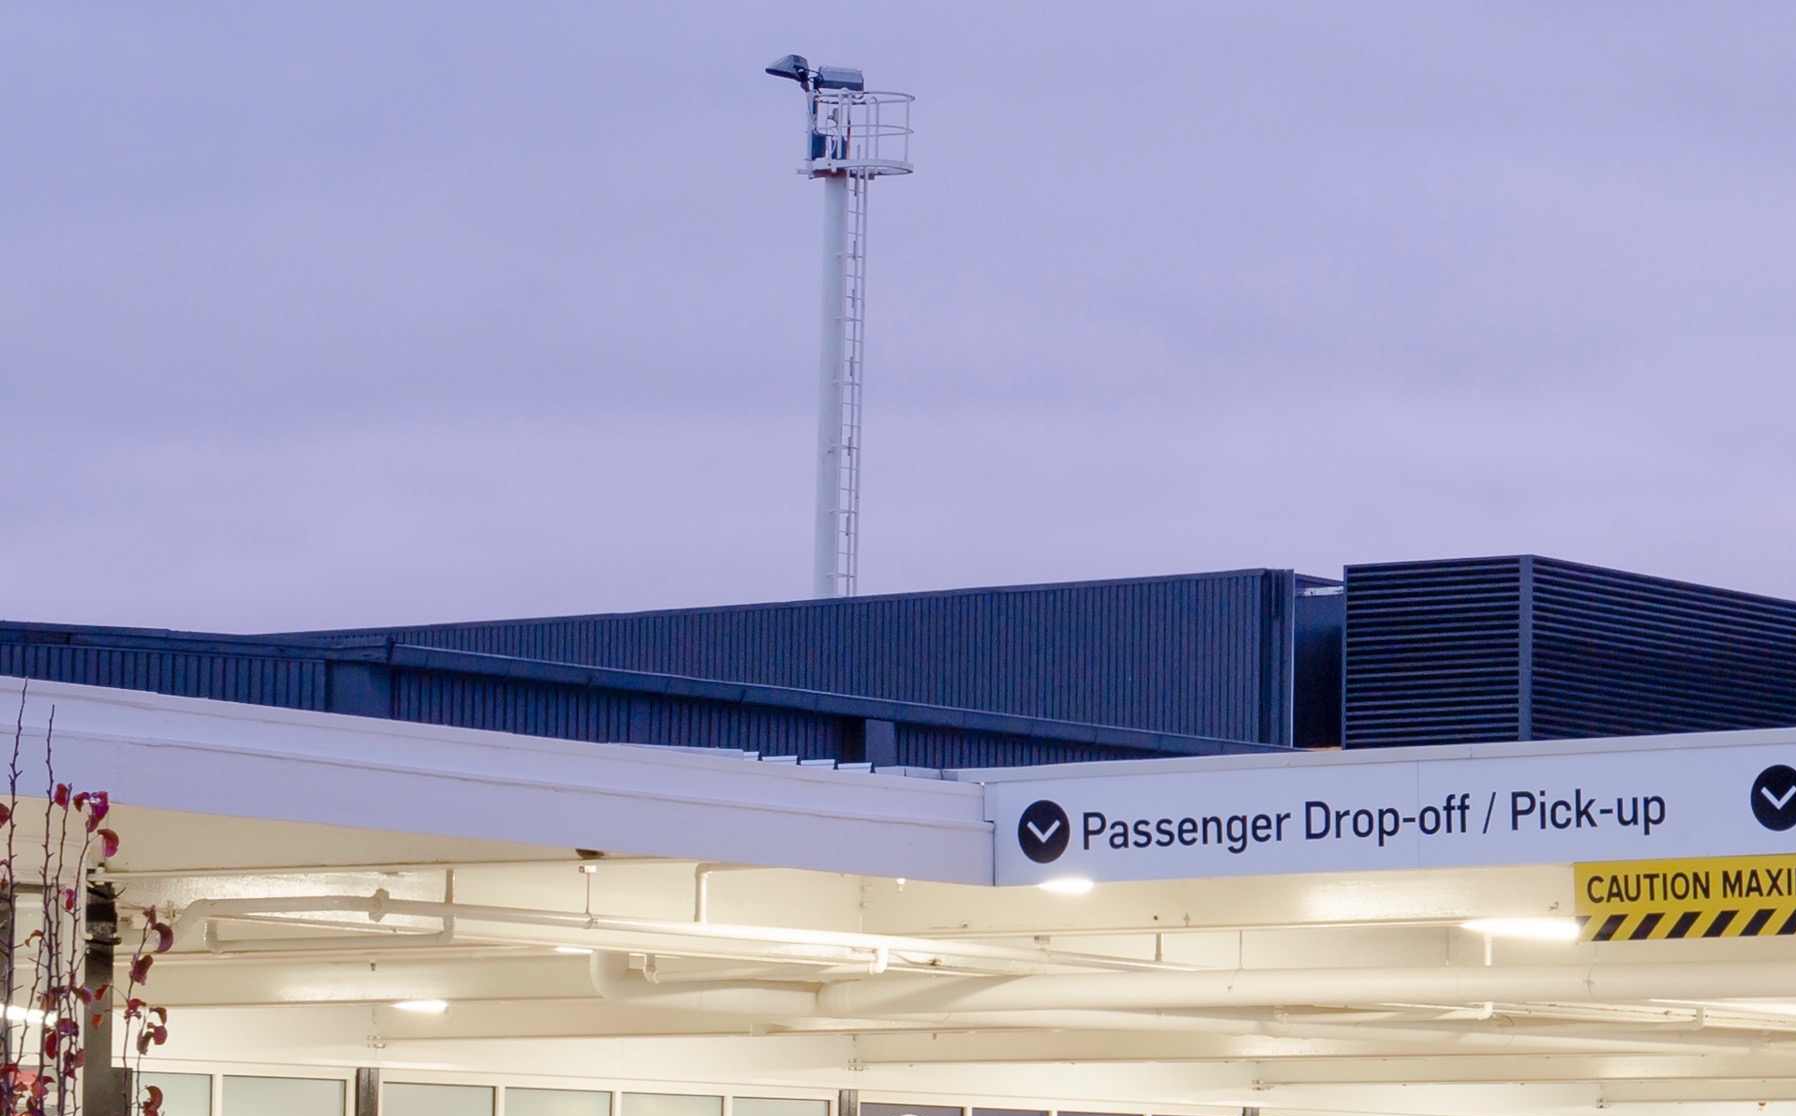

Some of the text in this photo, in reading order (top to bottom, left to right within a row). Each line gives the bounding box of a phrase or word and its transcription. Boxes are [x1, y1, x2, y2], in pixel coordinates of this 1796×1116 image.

[1082, 787, 1667, 854] Passenger Drop-off / Pick-up
[1586, 870, 1712, 906] CAUTION
